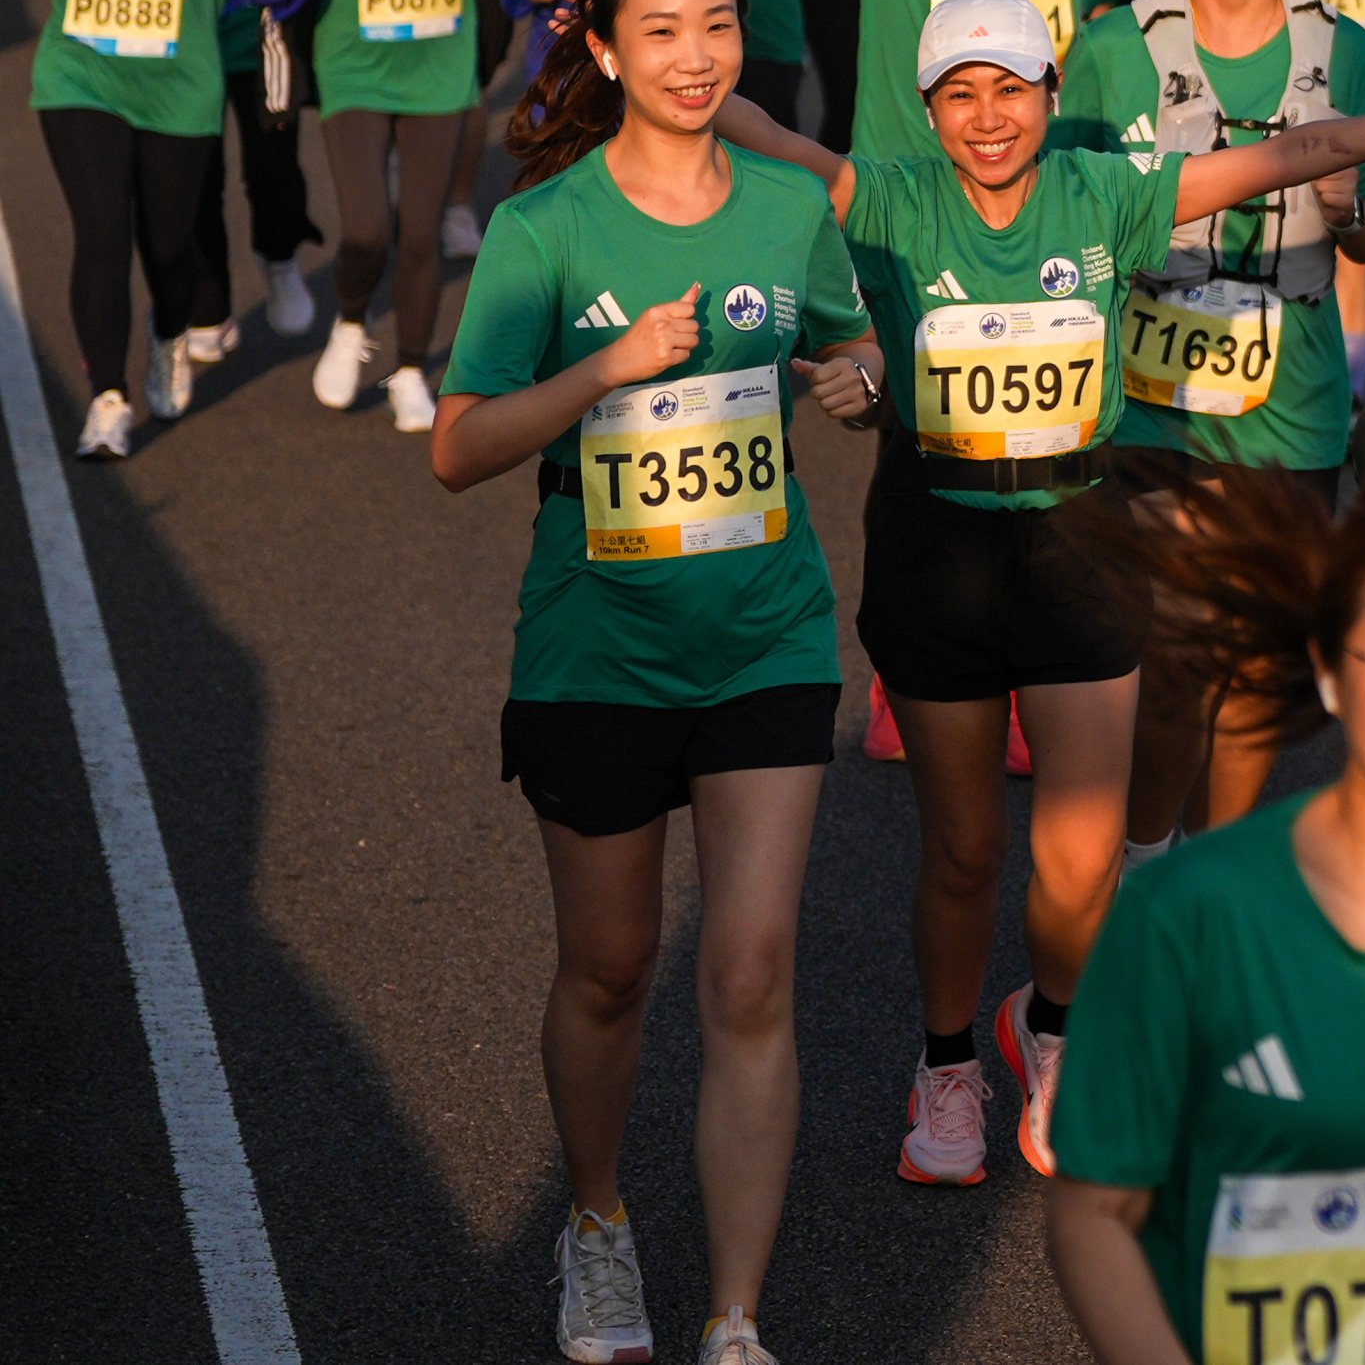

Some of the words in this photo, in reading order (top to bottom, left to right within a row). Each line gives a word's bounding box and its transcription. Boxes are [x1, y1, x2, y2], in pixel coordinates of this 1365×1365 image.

[1131, 309, 1270, 382] T1630
[926, 358, 1094, 416] T0597
[595, 435, 777, 510] T3538
[599, 535, 647, 547] 十公里七組
[599, 546, 621, 555] 10km
[623, 545, 642, 554] Run
[643, 545, 649, 553] 7
